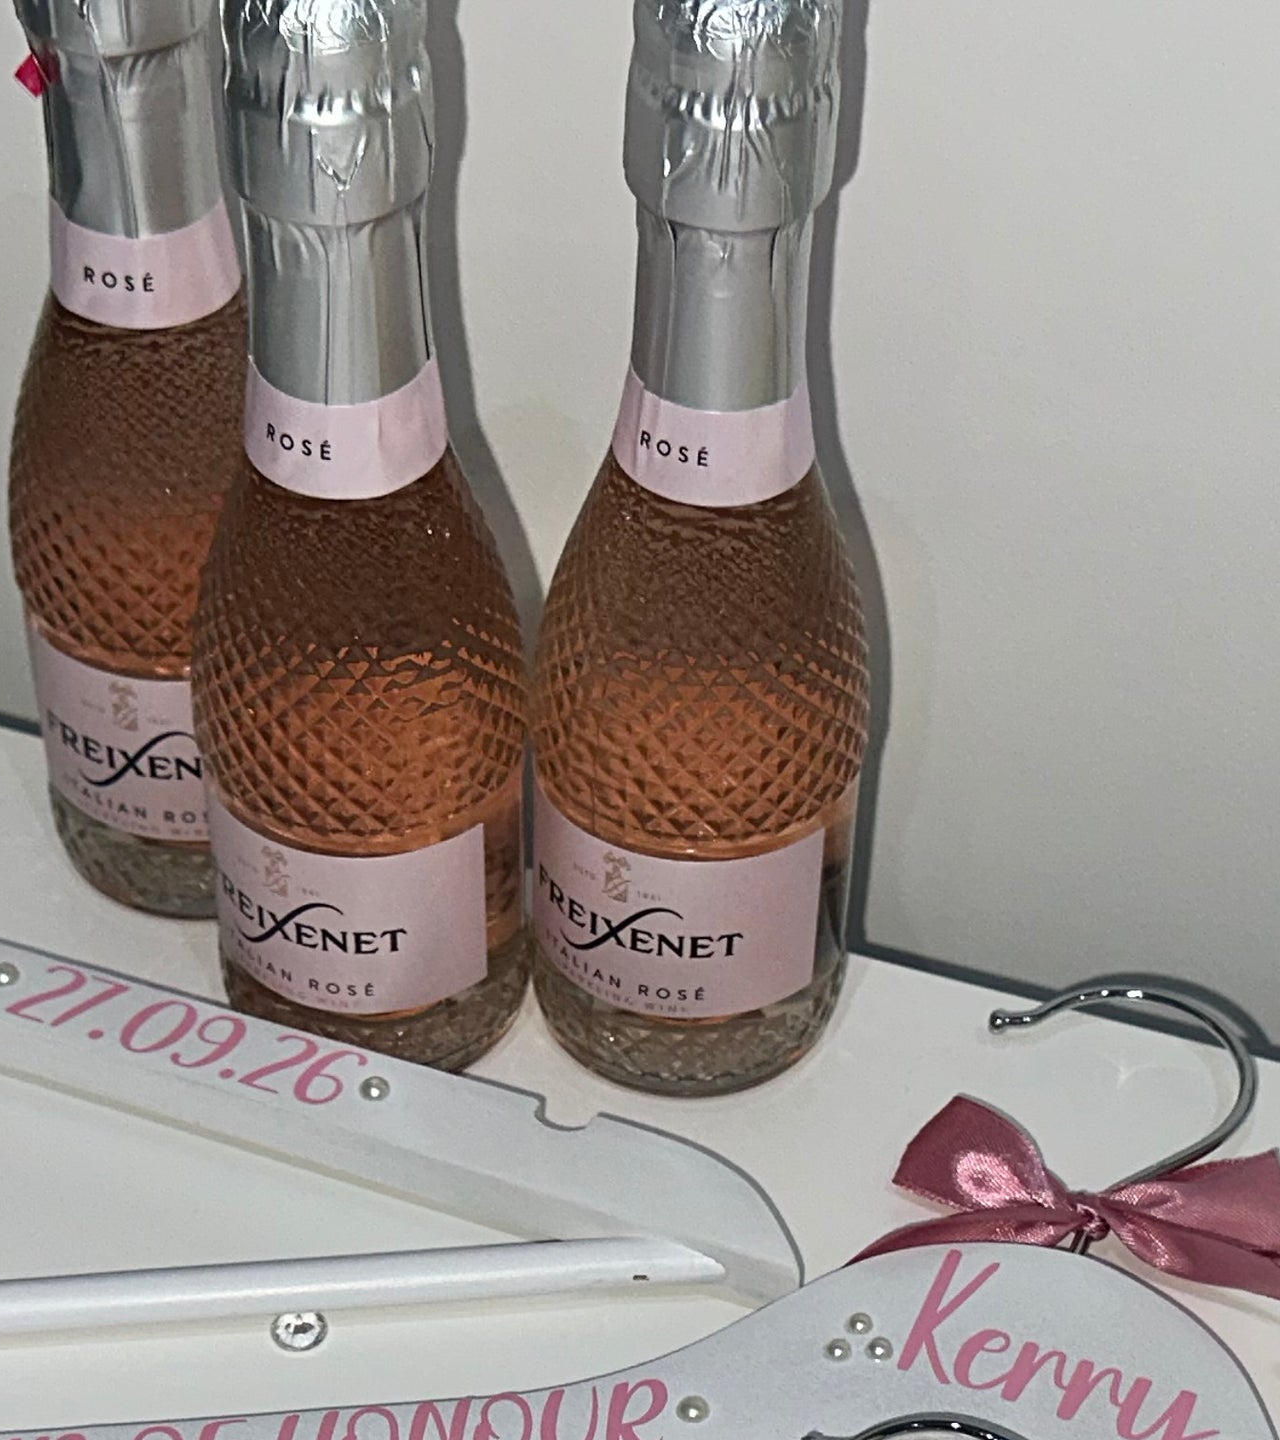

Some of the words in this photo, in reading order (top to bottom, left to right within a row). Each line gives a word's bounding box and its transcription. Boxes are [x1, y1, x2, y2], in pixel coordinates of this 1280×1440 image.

[84, 265, 154, 292] ROSÉ
[266, 423, 332, 461] ROSÉ
[640, 430, 709, 467] ROSÉ
[538, 861, 744, 959] FREIXENET
[545, 928, 621, 989] ITALIAN
[638, 984, 706, 1001] ROSÉ
[308, 978, 376, 997] ROSÉ
[5, 965, 368, 1105] 27.09.26
